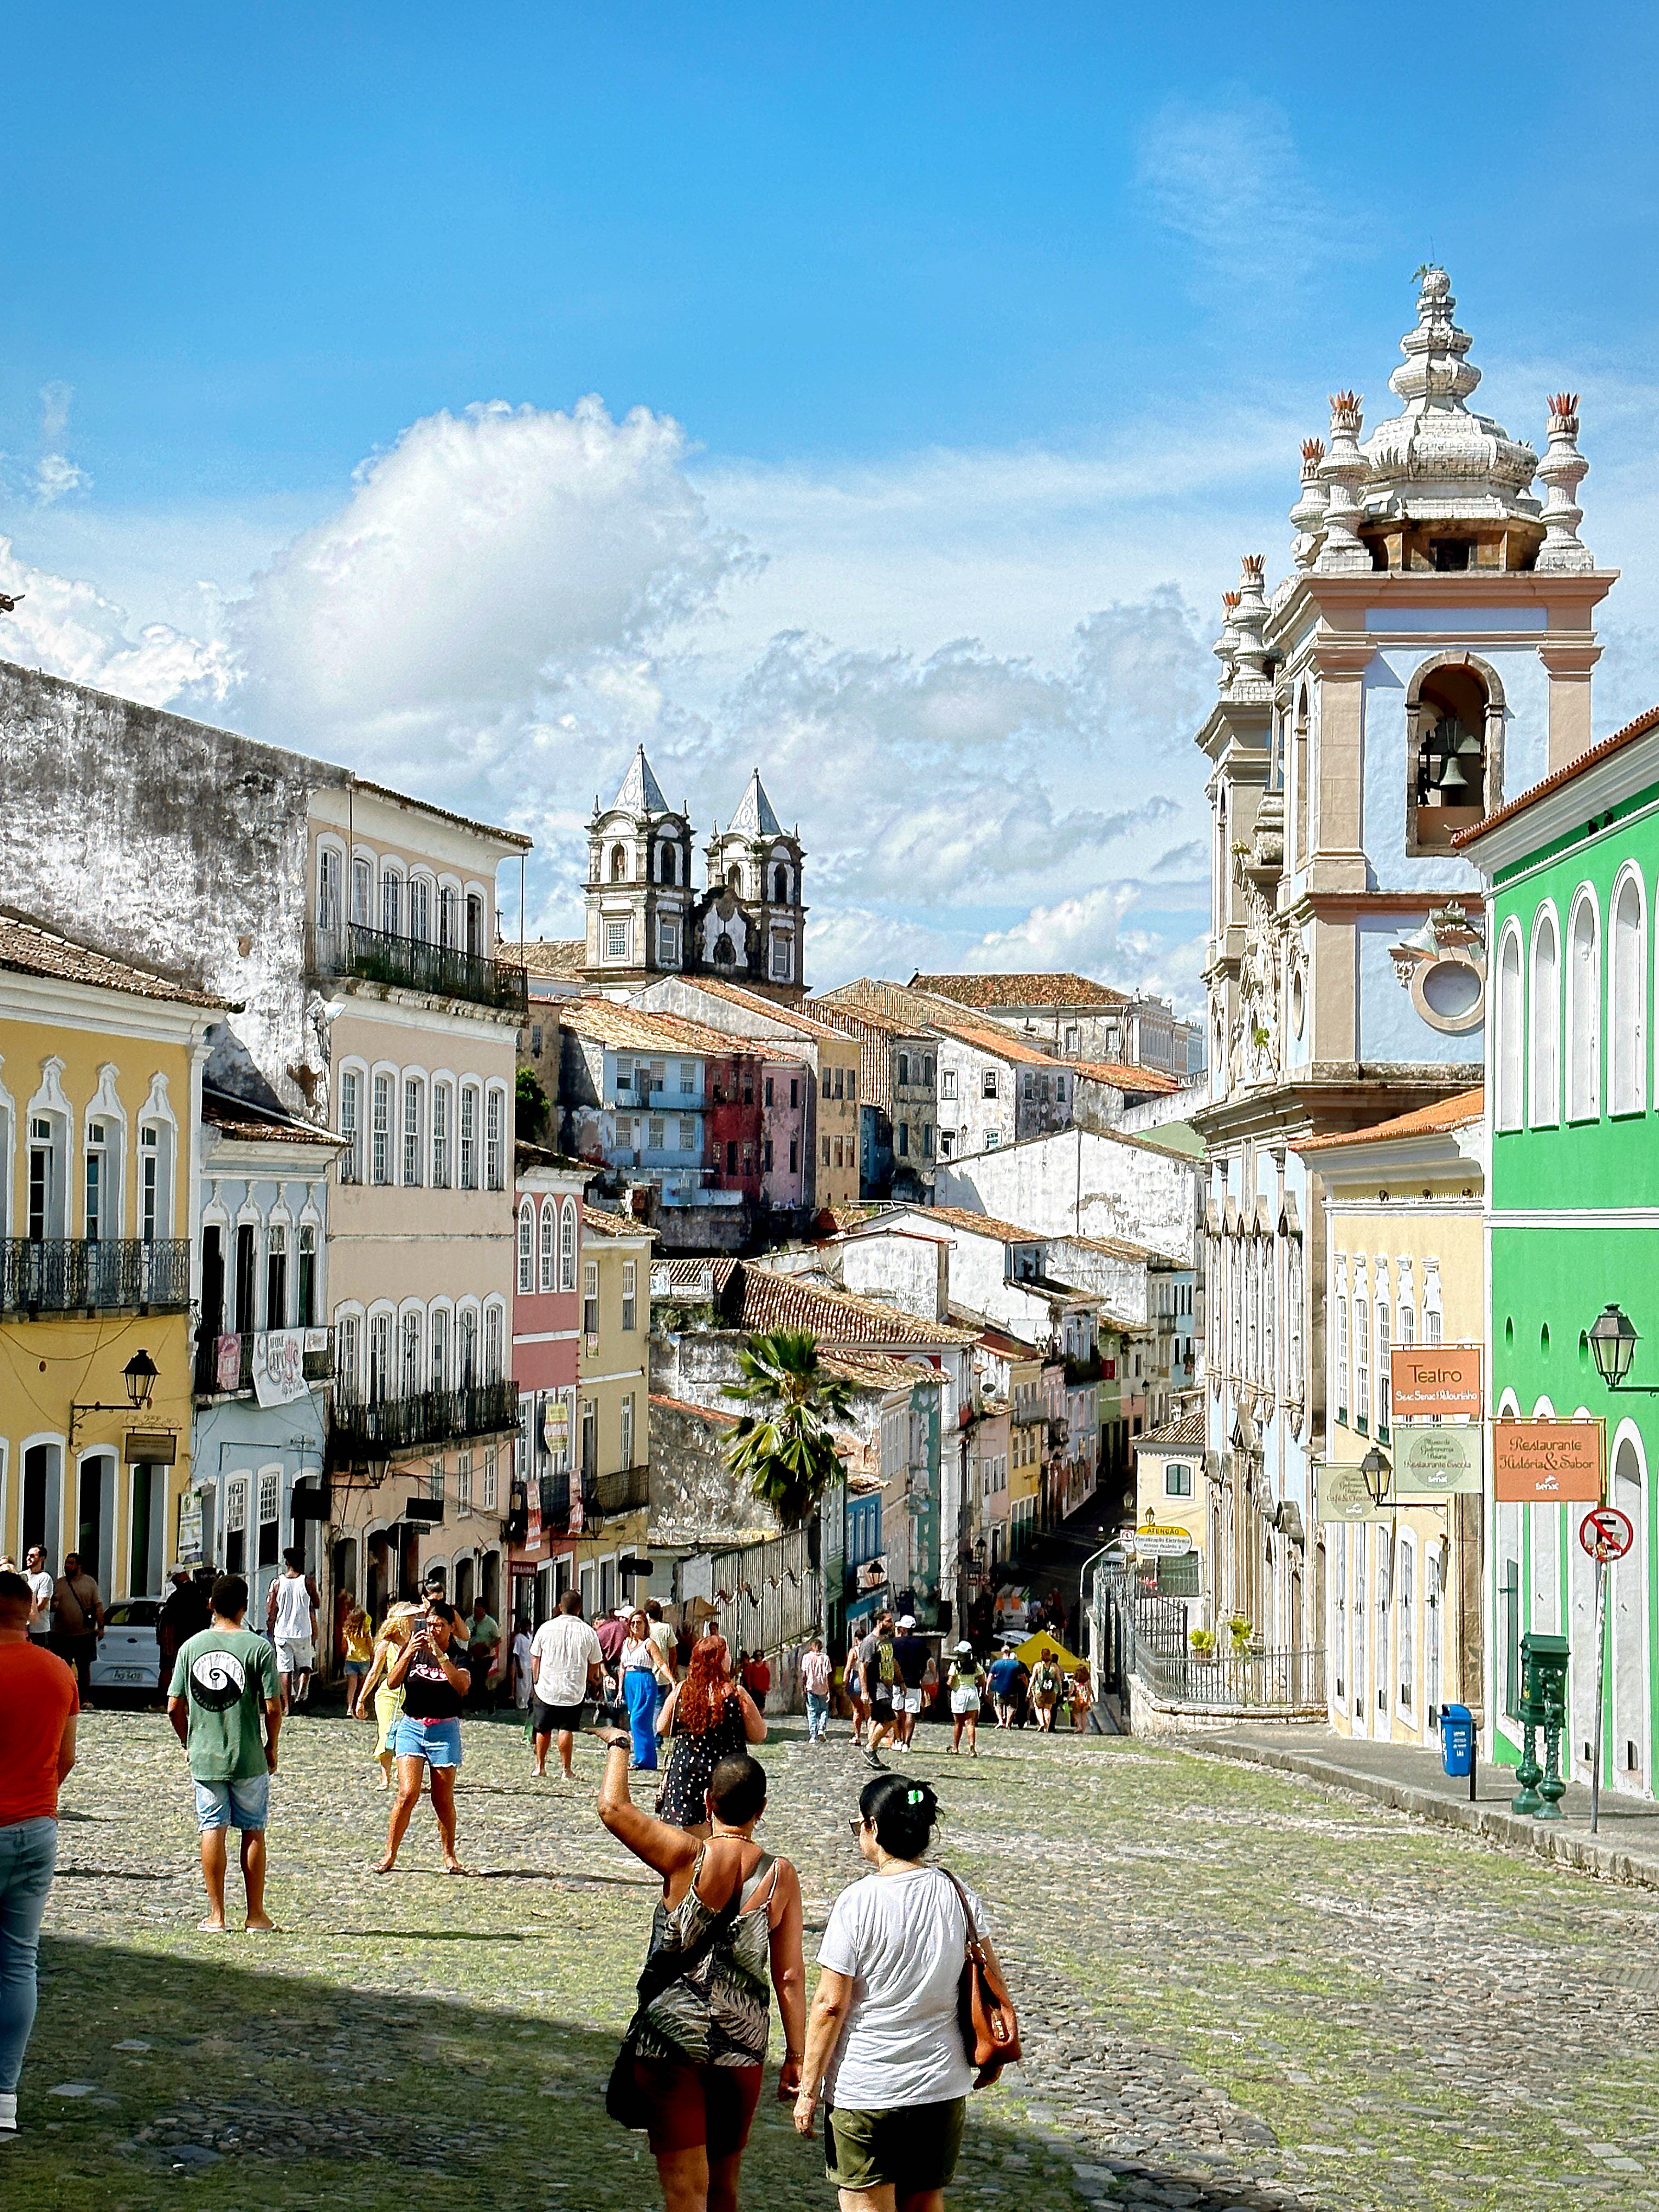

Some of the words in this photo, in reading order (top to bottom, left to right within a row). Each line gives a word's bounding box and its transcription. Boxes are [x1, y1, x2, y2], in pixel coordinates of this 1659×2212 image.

[1407, 1364, 1462, 1383] Teatro
[1509, 1436, 1582, 1451] Restaurante
[1544, 1451, 1558, 1470] &
[1559, 1455, 1594, 1469] Sabor
